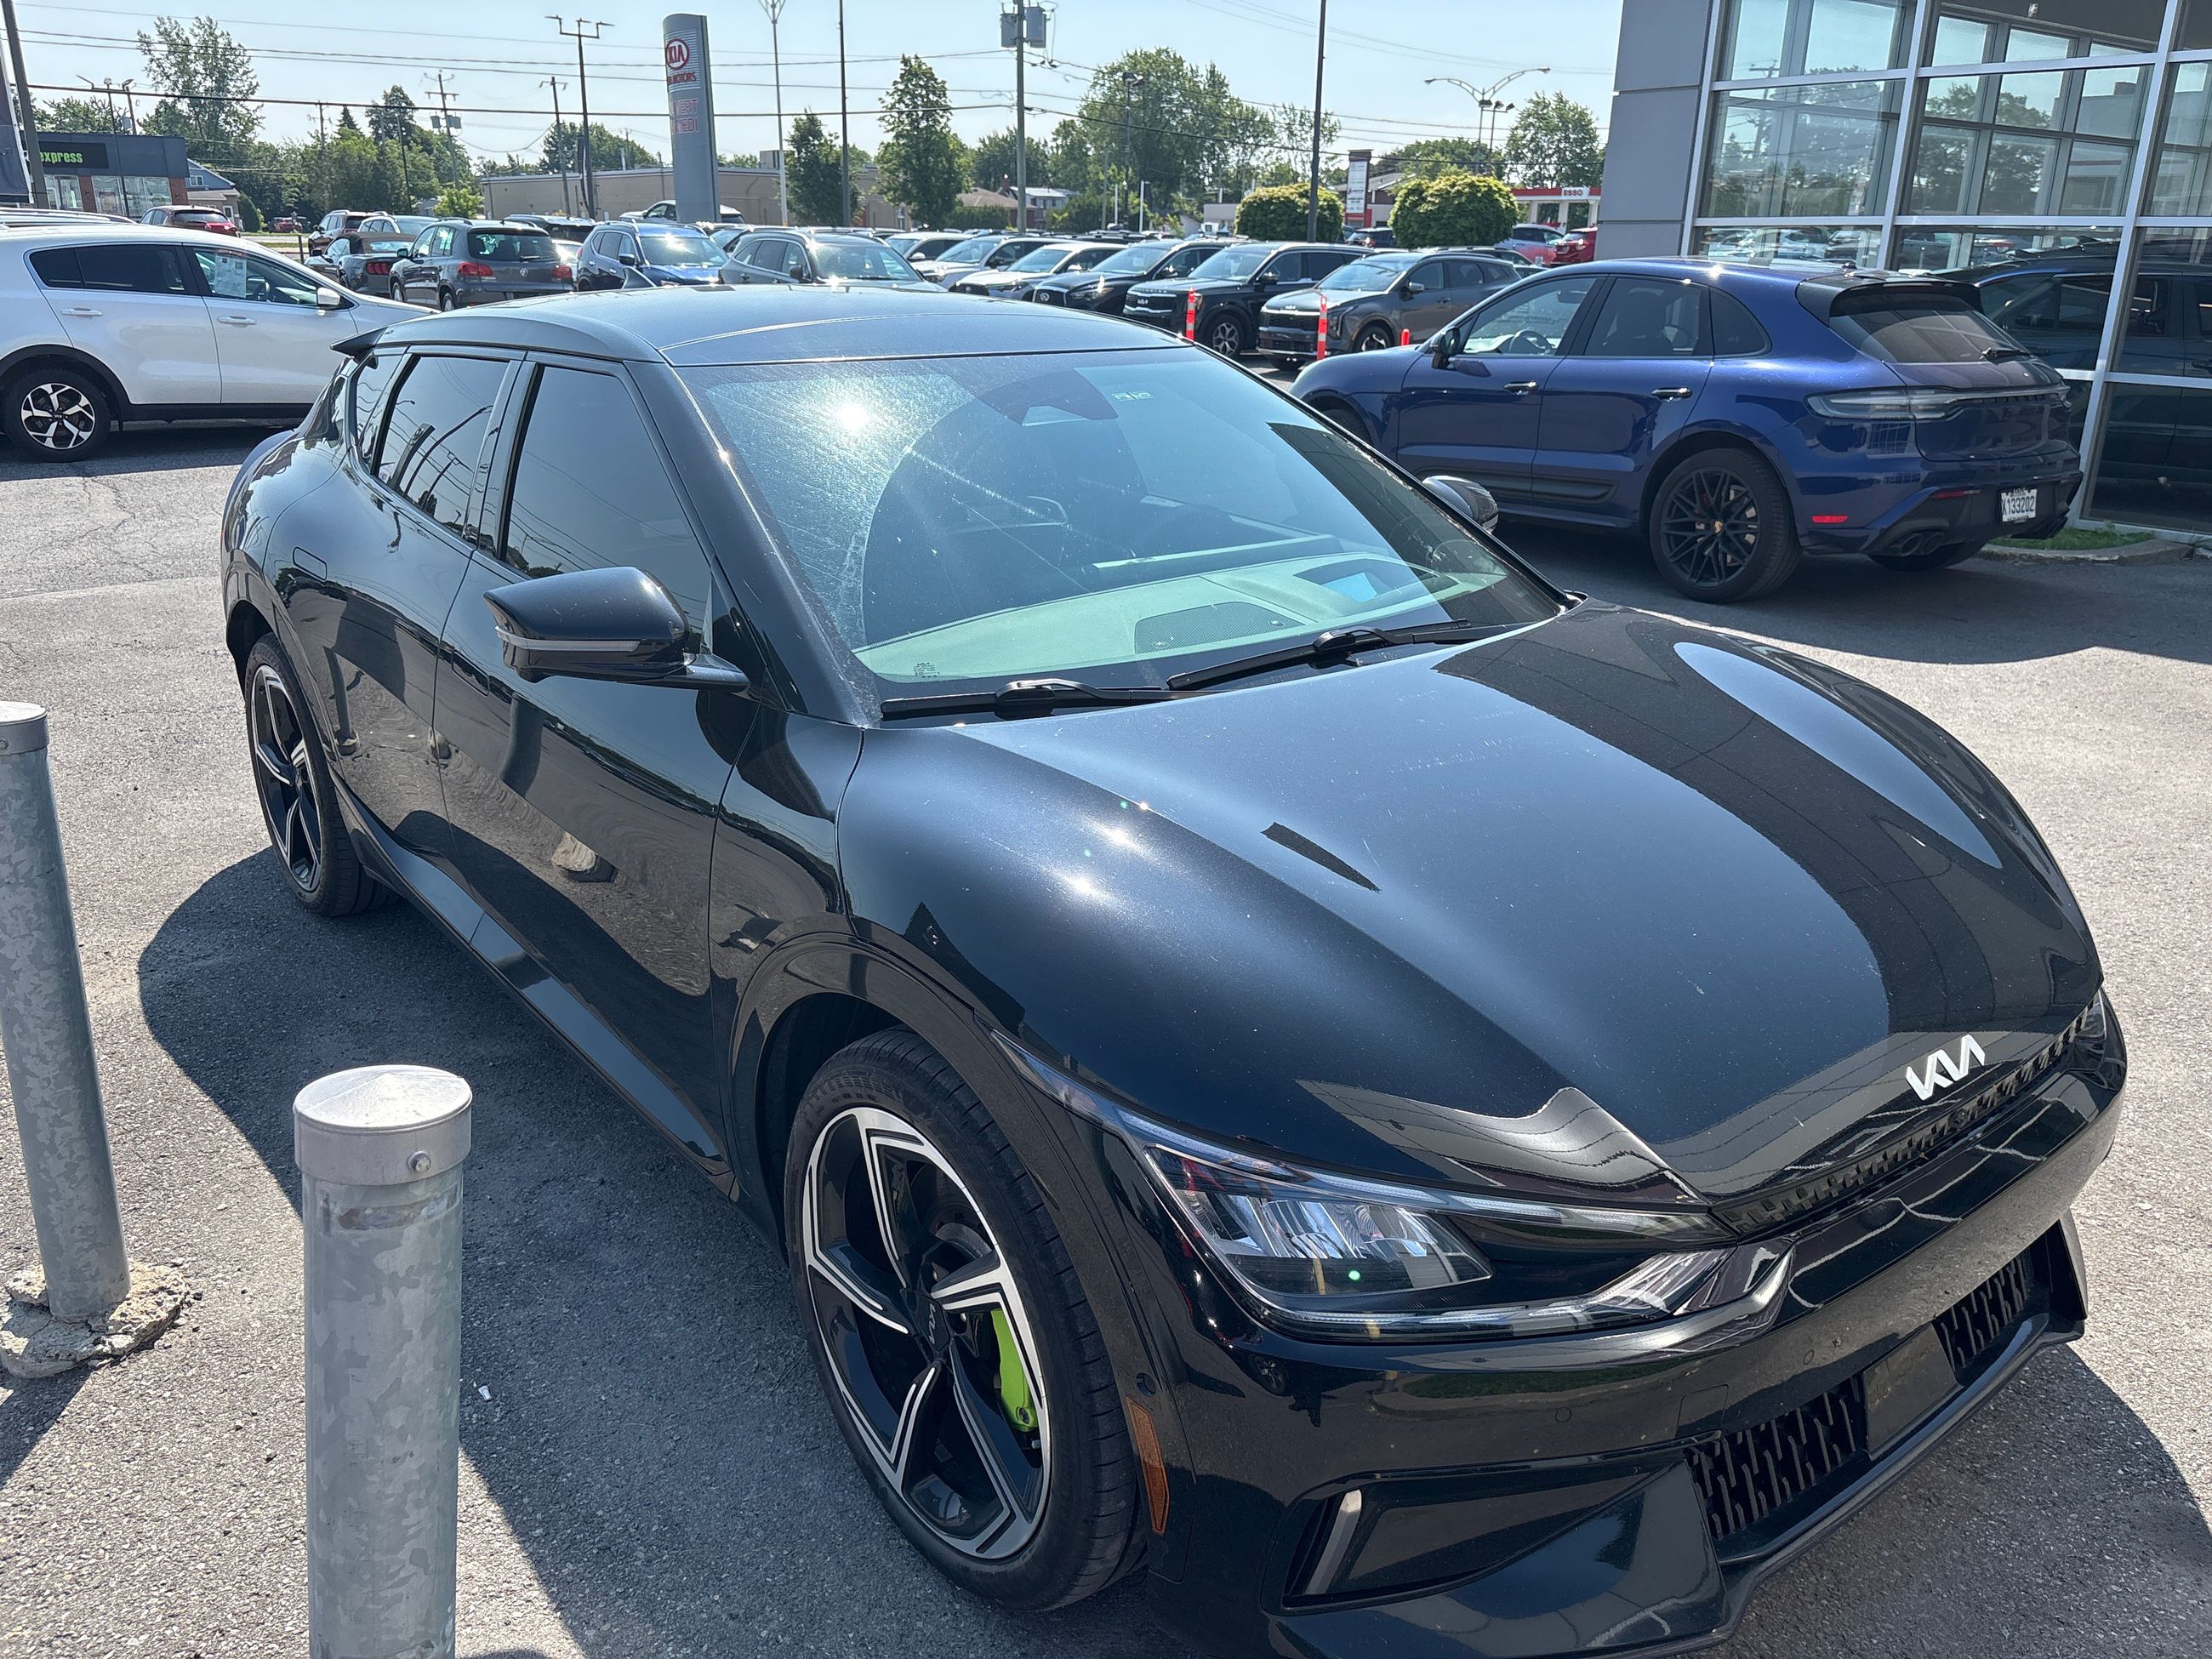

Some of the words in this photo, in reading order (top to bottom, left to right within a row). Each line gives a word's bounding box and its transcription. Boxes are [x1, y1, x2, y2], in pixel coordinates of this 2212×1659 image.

[668, 44, 685, 64] KIA
[39, 151, 83, 164] express
[1905, 1034, 1986, 1101] KIA
